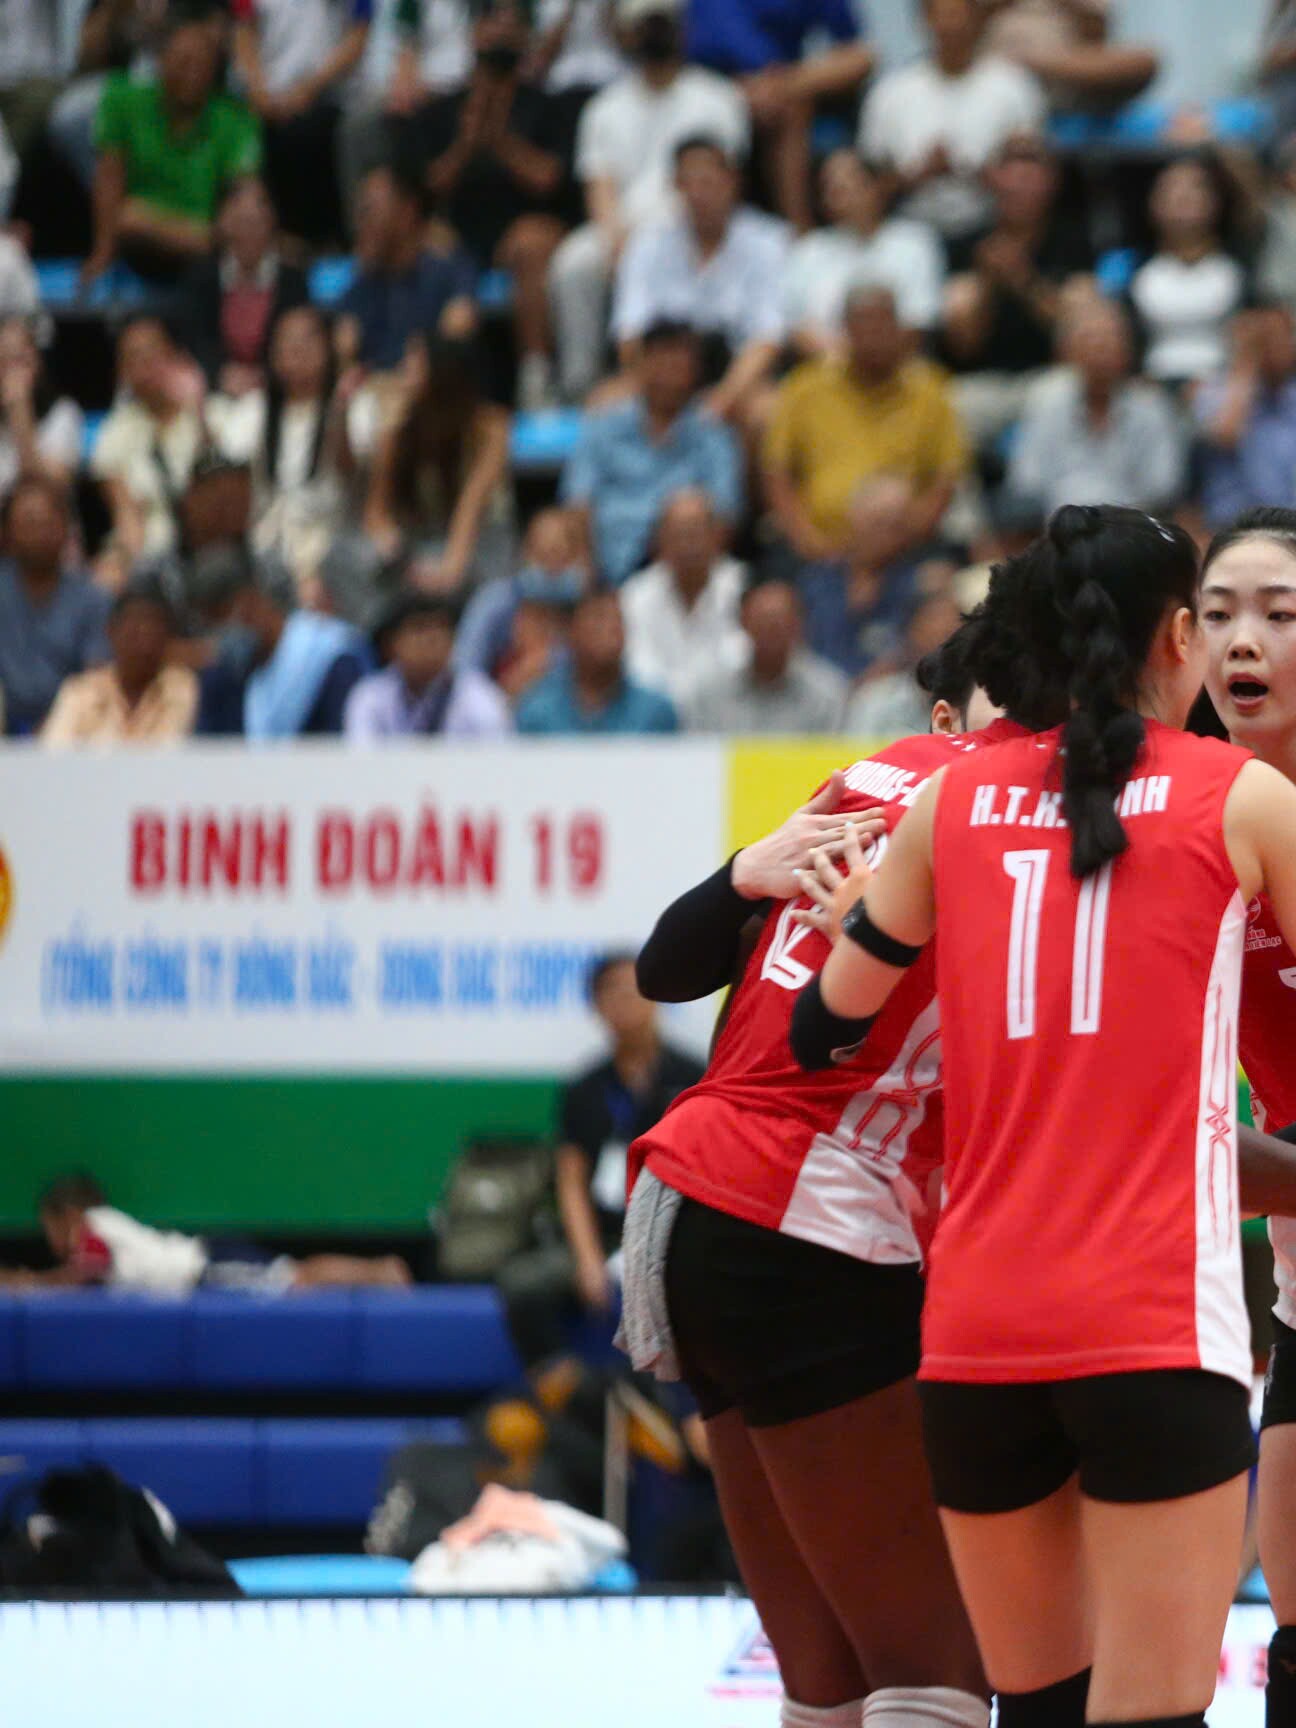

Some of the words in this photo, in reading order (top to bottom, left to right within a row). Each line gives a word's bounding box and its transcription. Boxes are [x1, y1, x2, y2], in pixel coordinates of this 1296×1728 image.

[130, 808, 292, 893] BINH
[315, 787, 499, 893] ĐOÀN
[530, 812, 606, 893] 19
[1003, 848, 1113, 1040] 11
